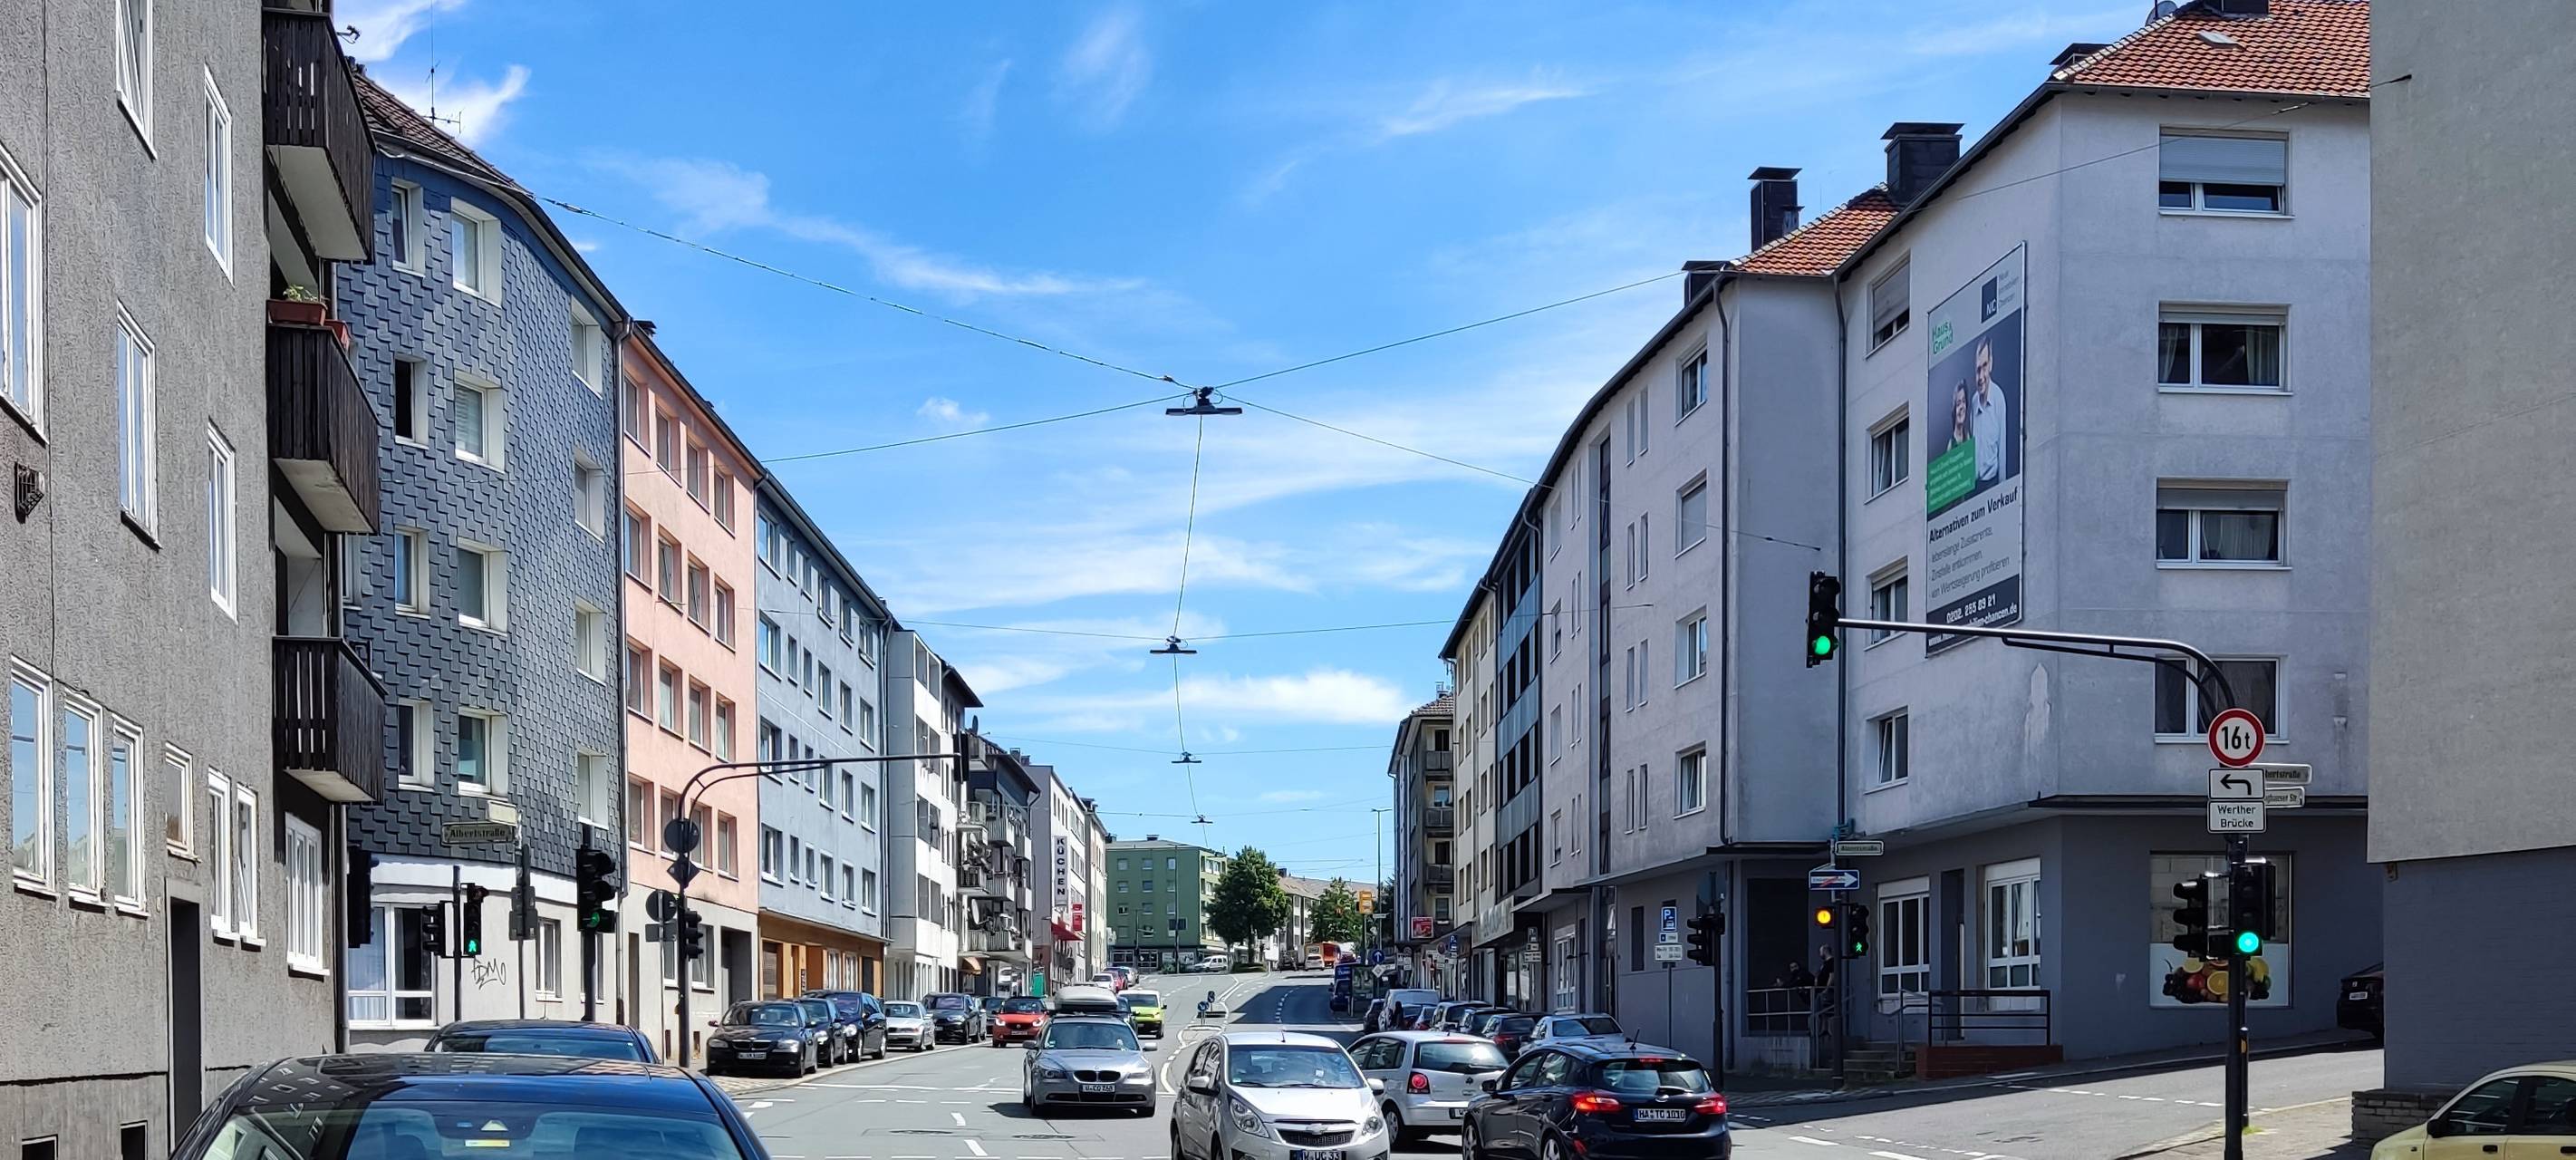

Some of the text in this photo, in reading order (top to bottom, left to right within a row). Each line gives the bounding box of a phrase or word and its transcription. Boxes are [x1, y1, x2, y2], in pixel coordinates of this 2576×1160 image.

[1933, 321, 1948, 343] Haus
[1934, 330, 1954, 354] Grund
[1929, 486, 2018, 544] Alternativen zum Verkauf
[2217, 804, 2256, 815] Werther
[450, 827, 507, 838] Albertstraße
[2220, 817, 2254, 828] Brücke
[1056, 837, 1066, 896] KÜCHEN
